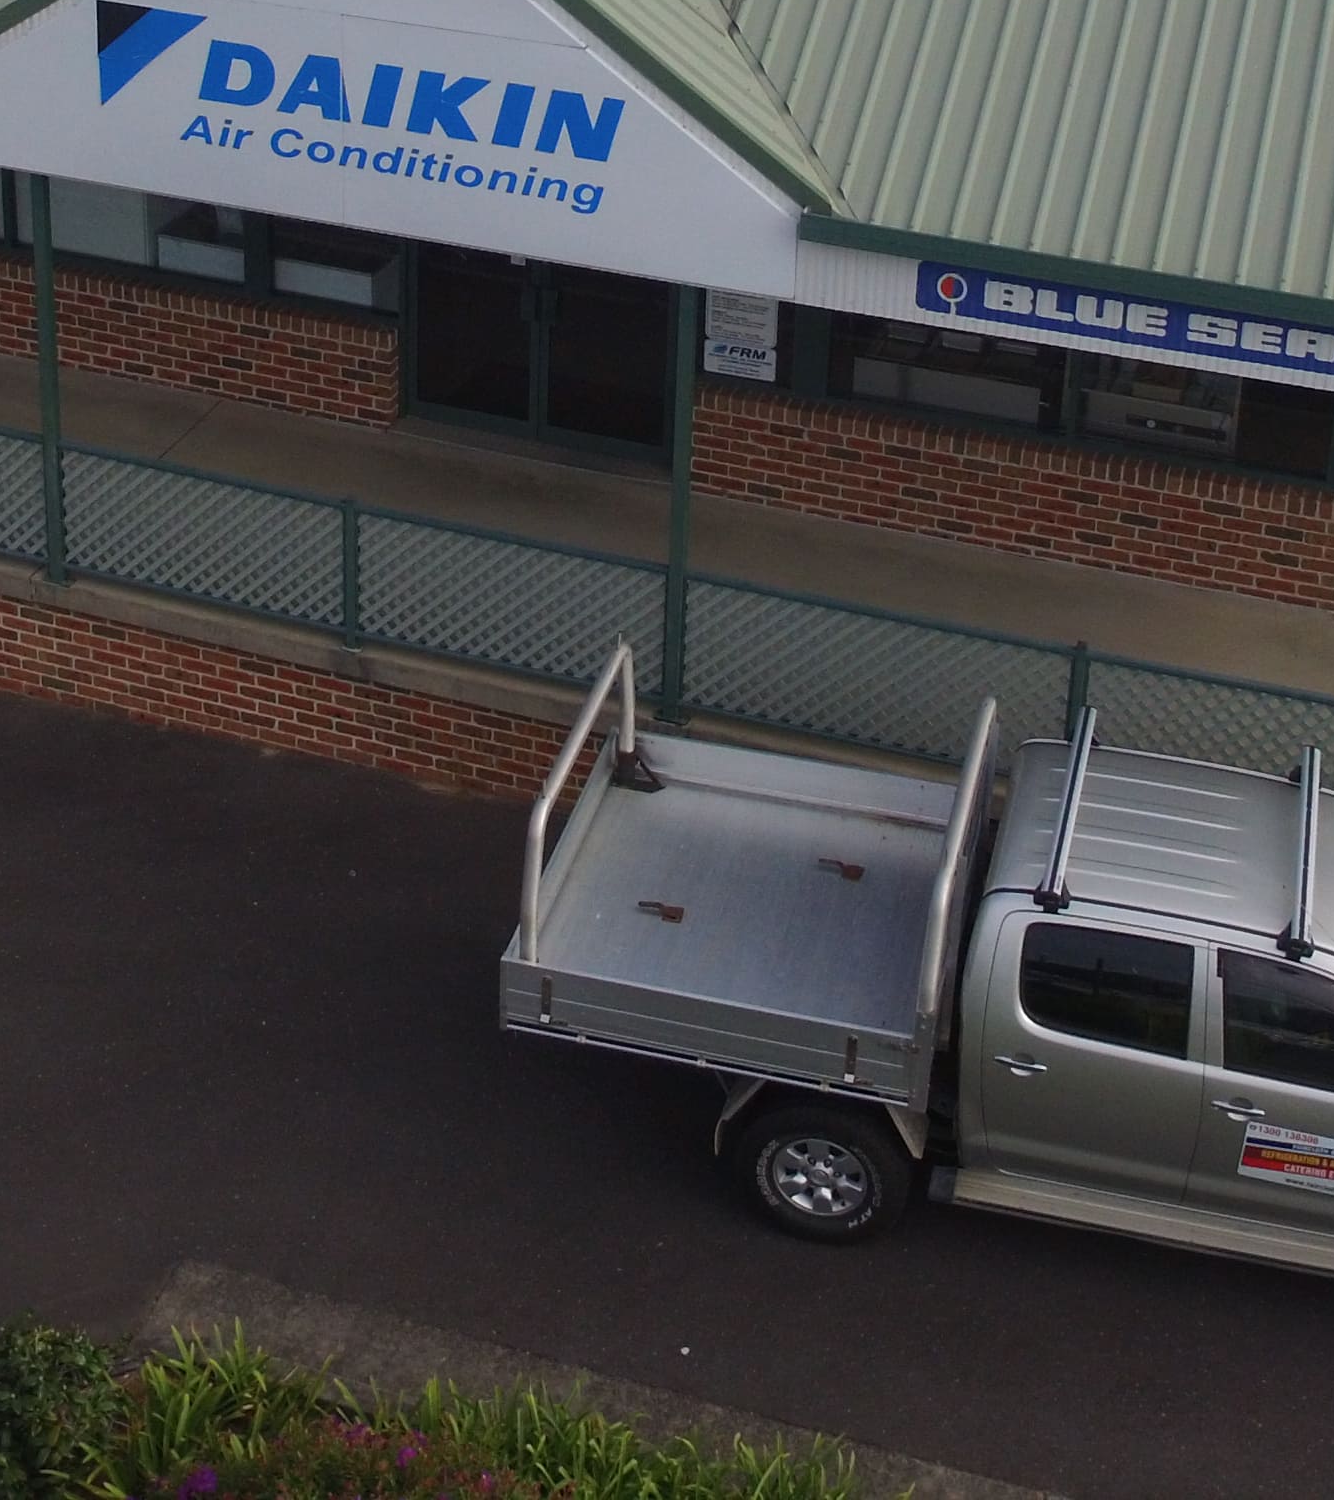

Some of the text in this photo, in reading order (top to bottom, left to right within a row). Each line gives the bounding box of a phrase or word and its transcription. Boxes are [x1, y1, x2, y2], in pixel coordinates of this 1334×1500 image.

[198, 38, 626, 162] DAIKIN
[180, 114, 605, 215] Air Conditioning
[984, 279, 1168, 337] BLUE
[728, 345, 768, 361] FRM
[1283, 1164, 1327, 1179] CATERING
